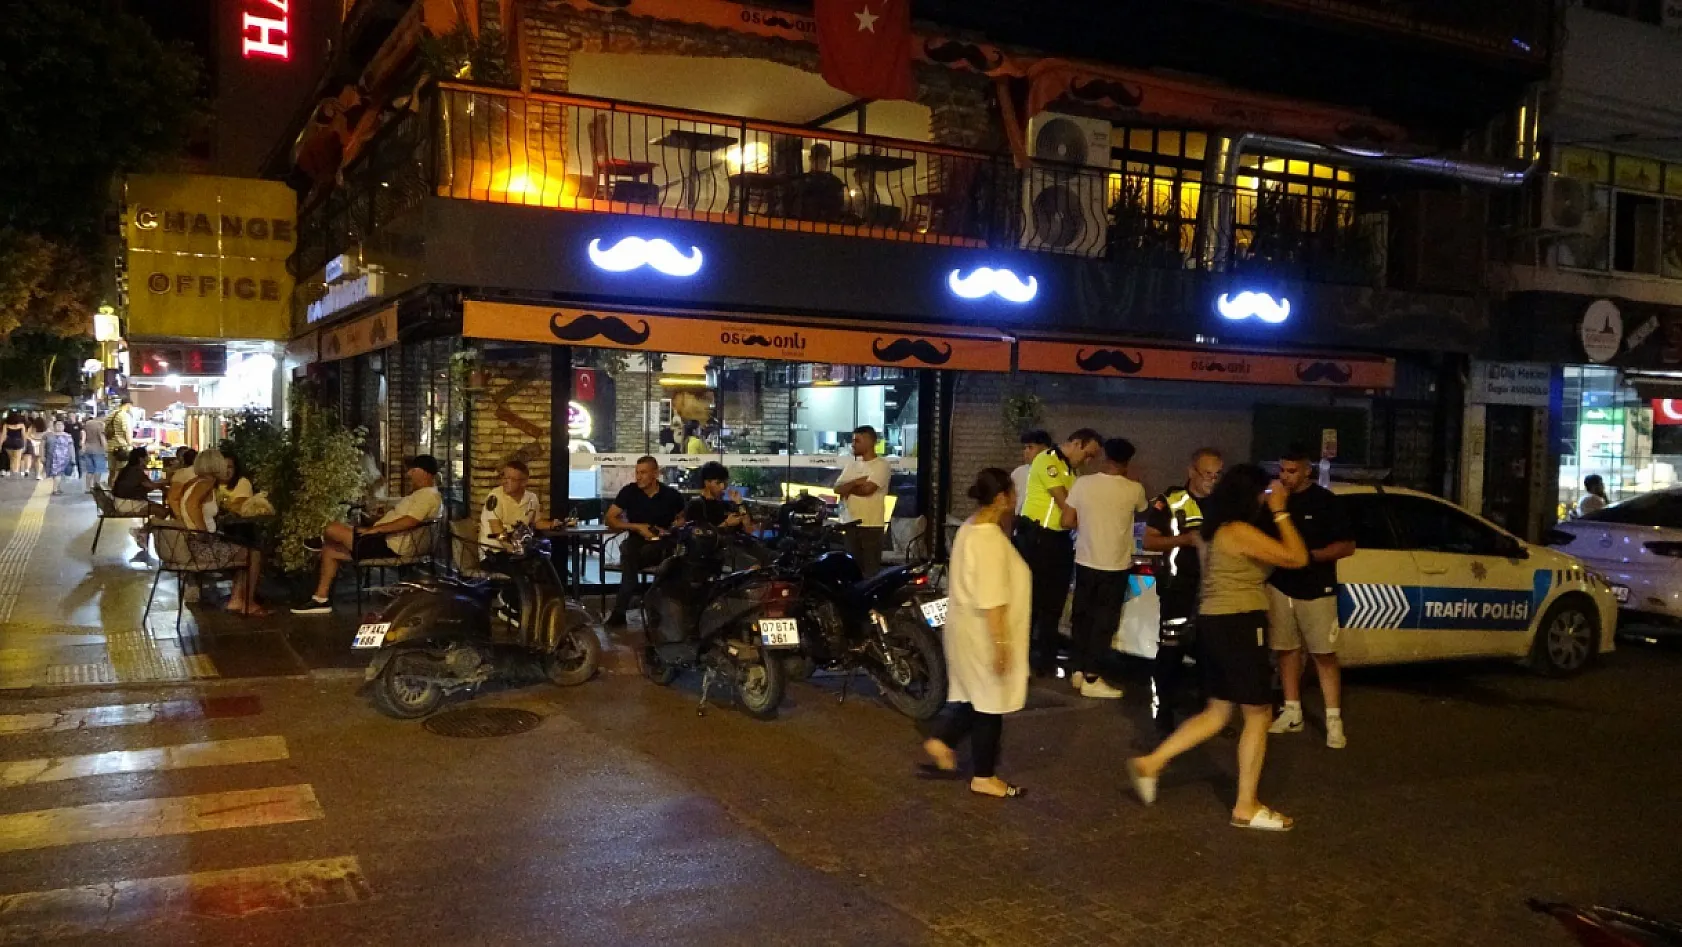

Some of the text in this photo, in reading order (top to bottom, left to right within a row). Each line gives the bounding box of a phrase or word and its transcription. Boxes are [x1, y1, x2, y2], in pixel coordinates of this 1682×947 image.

[135, 206, 291, 243] CHANGE
[148, 271, 280, 301] OFFICE
[1424, 597, 1529, 621] TRAFİK POLİSİ
[770, 633, 788, 643] 361
